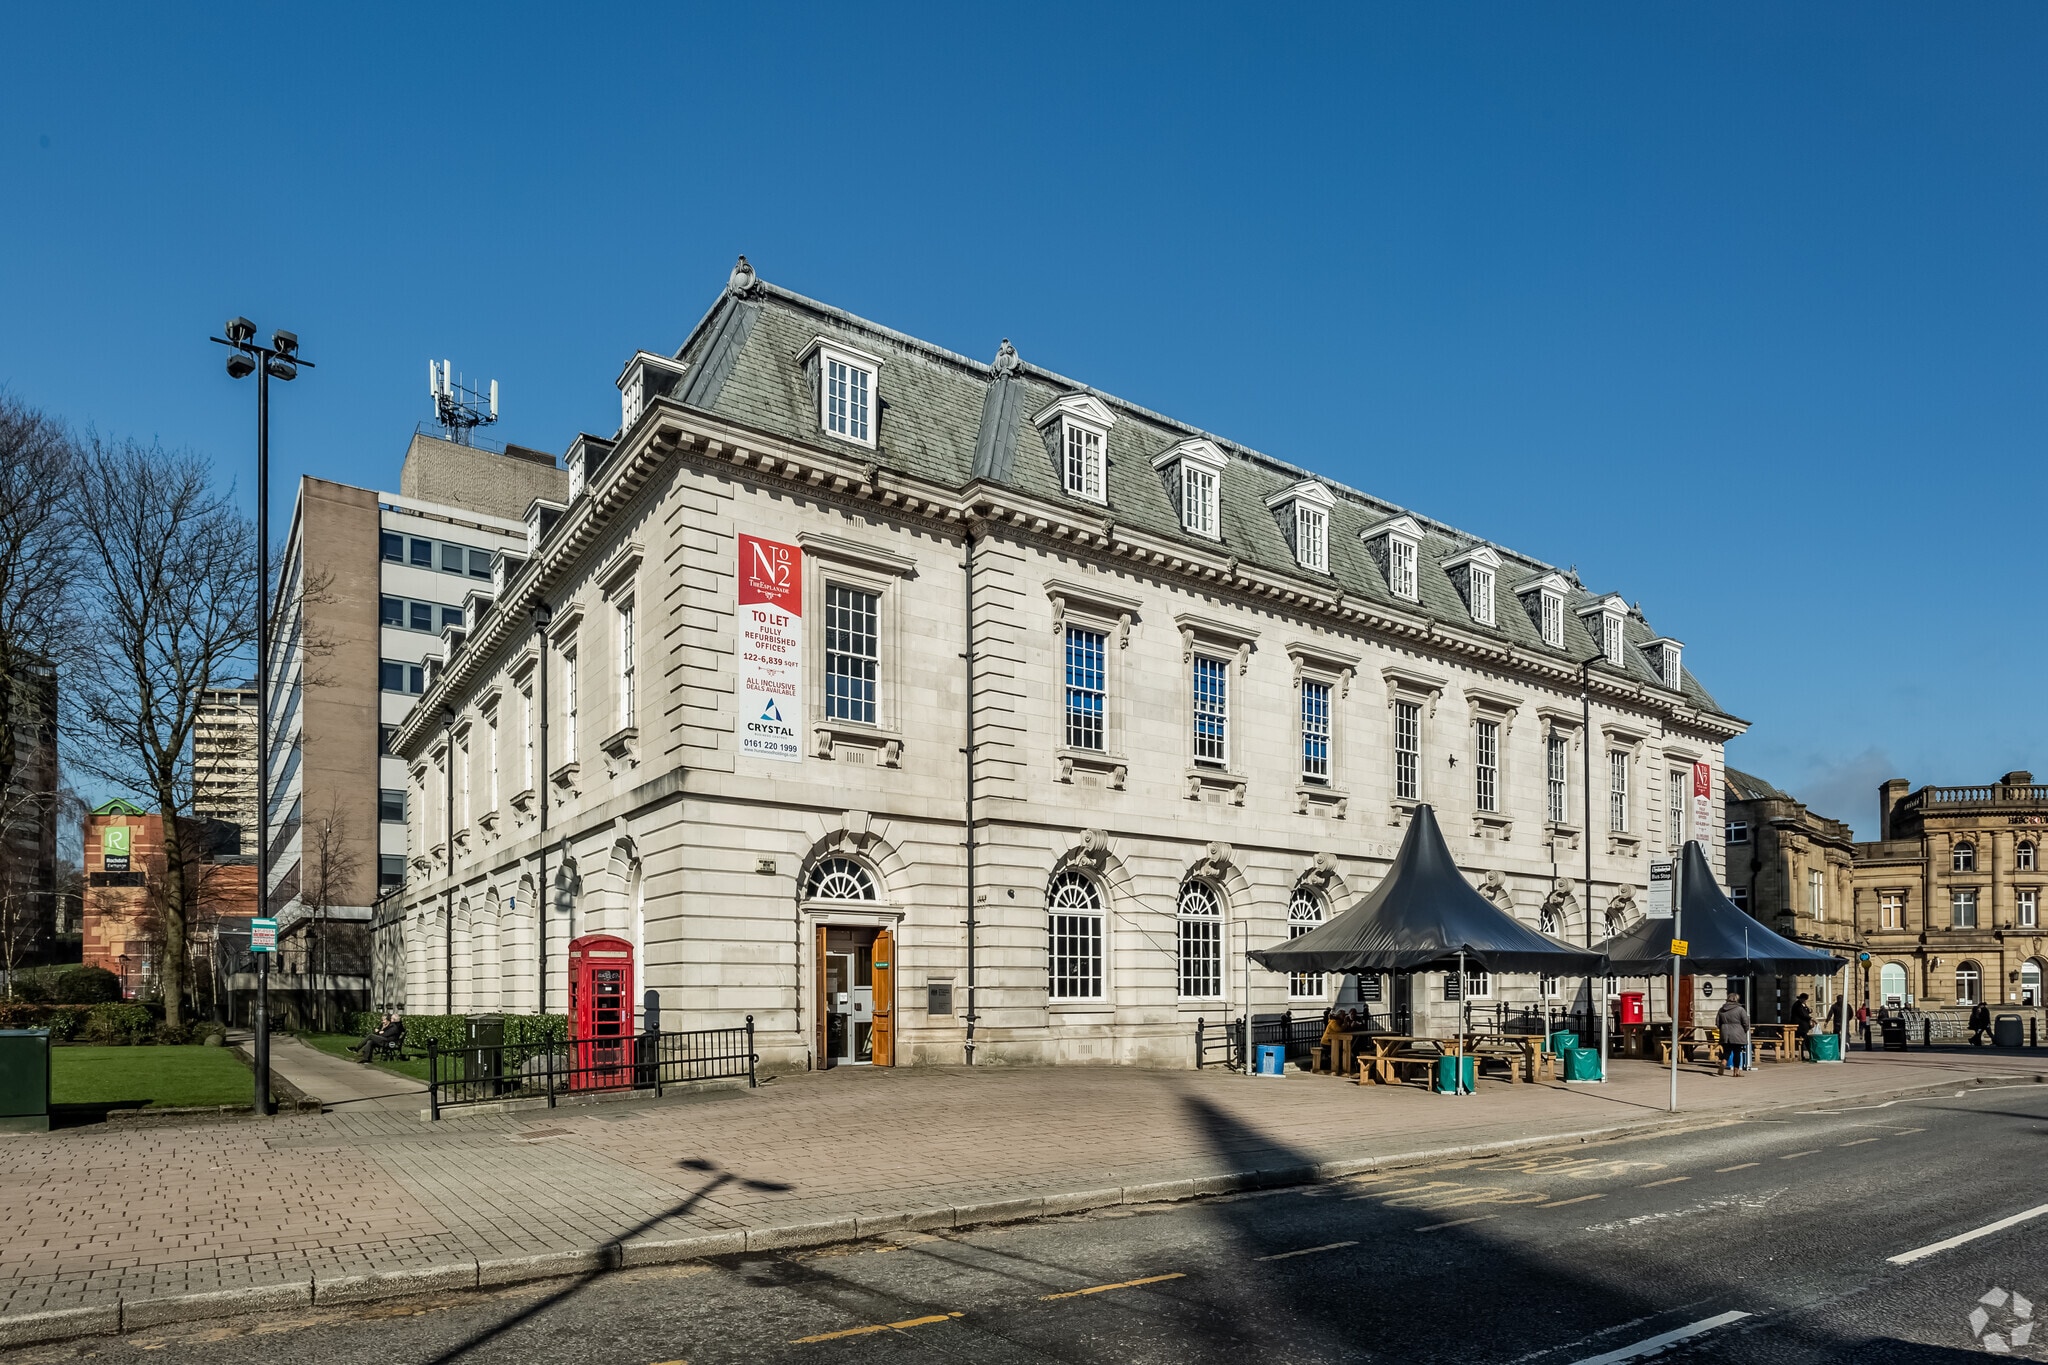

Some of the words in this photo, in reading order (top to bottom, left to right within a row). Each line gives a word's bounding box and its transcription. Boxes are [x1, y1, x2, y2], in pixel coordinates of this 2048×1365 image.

[752, 610, 767, 623] TO
[769, 614, 789, 627] LET
[760, 626, 782, 636] FULLY
[745, 631, 796, 647] REFURBISHED
[755, 642, 786, 653] OFFICES
[743, 652, 783, 666] 122-6,839
[746, 677, 759, 685] ALL
[761, 680, 796, 691] INCLUSIVE
[746, 684, 765, 692] DEALS
[766, 687, 796, 696] AVAILABLE
[747, 723, 794, 736] CRYSTAL
[744, 738, 762, 748] 0161
[764, 741, 778, 750] 220
[780, 744, 797, 753] 1999
[1478, 1156, 1666, 1179] BUS
